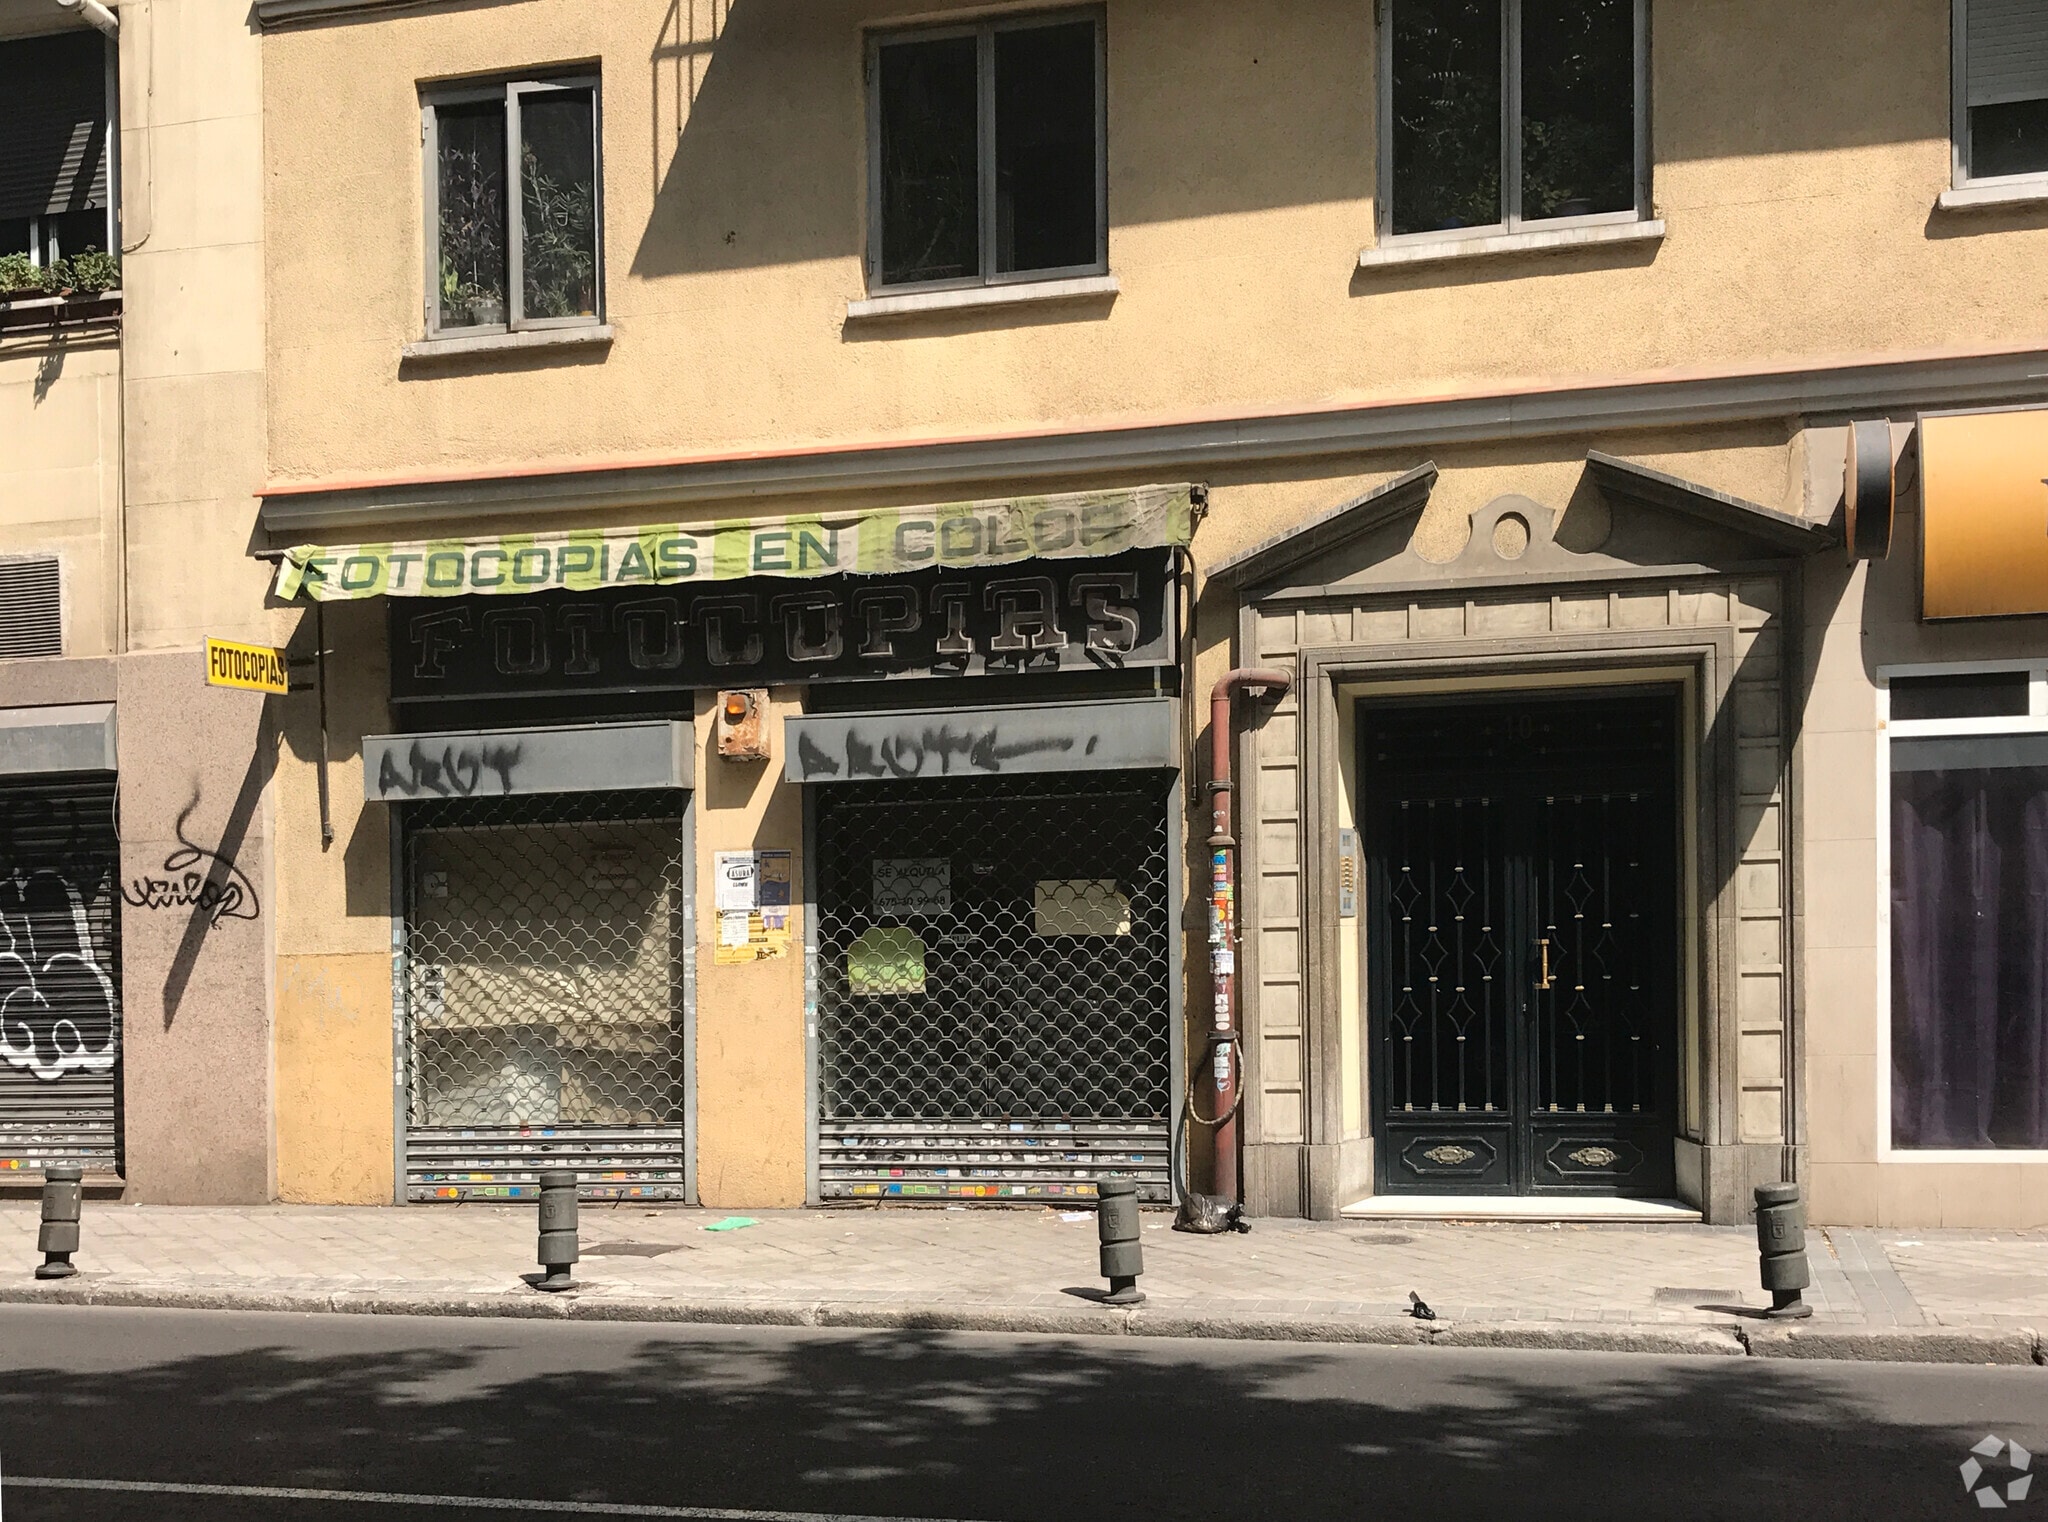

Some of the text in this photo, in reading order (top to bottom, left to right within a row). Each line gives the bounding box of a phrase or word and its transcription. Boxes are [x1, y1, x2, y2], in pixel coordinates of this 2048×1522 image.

[300, 503, 1126, 590] FOTOCOPIAS EN COLOR
[409, 572, 1141, 680] FOTOCOPIAS
[211, 646, 285, 686] FOTOCOPIAS
[878, 866, 946, 878] SE ALQUILA
